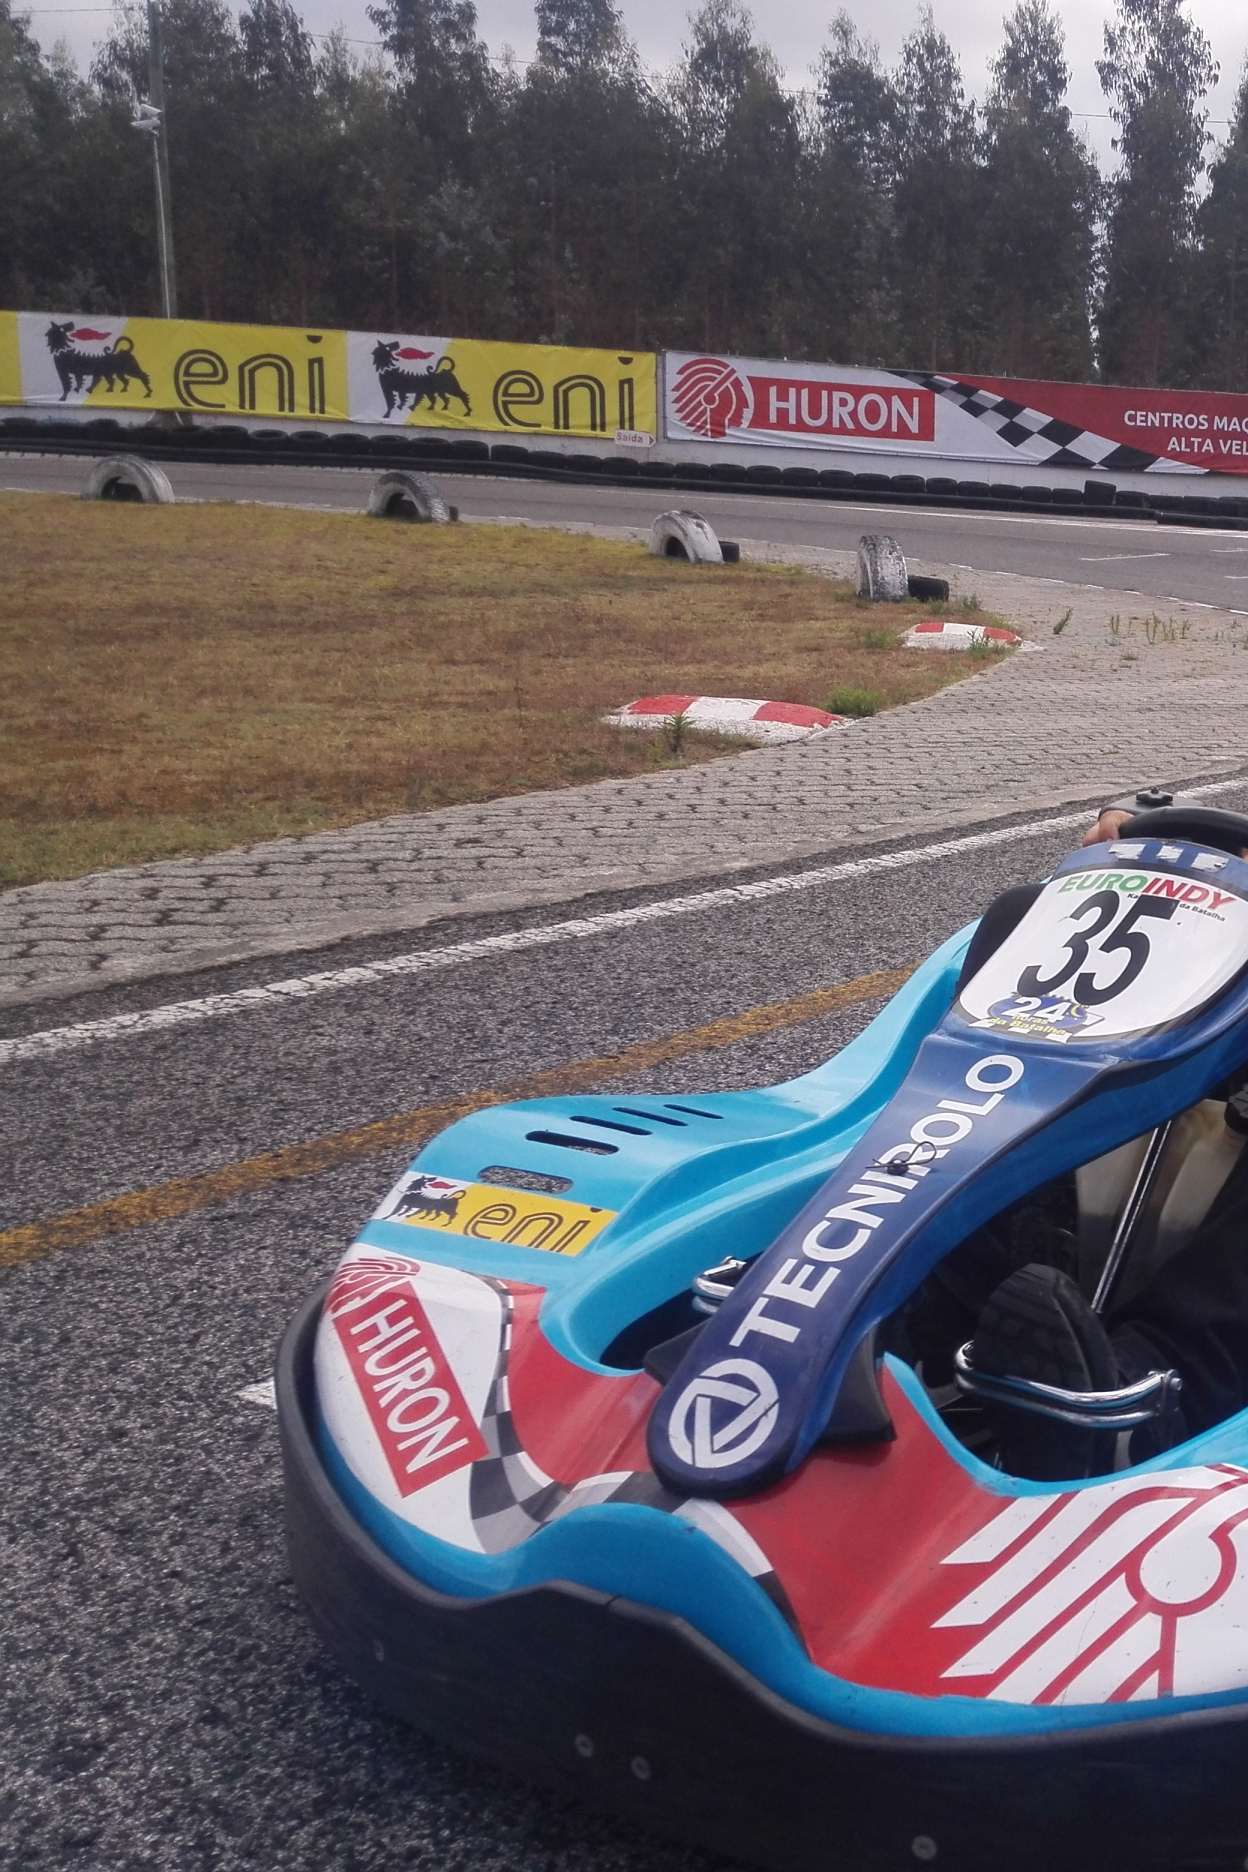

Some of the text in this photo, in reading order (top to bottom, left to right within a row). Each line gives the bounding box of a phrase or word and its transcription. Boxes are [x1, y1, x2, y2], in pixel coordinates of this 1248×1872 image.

[174, 335, 326, 414] eni
[493, 356, 635, 432] eni
[769, 385, 920, 434] HURON
[1124, 410, 1209, 430] CENTROS
[1167, 436, 1214, 453] ALTA
[1057, 872, 1238, 910] EUROINDY
[1191, 905, 1226, 922] Batalha
[1016, 889, 1181, 1006] 35
[1001, 996, 1072, 1022] 24
[728, 1054, 1026, 1348] TECNIROLO
[463, 1202, 603, 1253] eni
[350, 1299, 470, 1474] HURON
